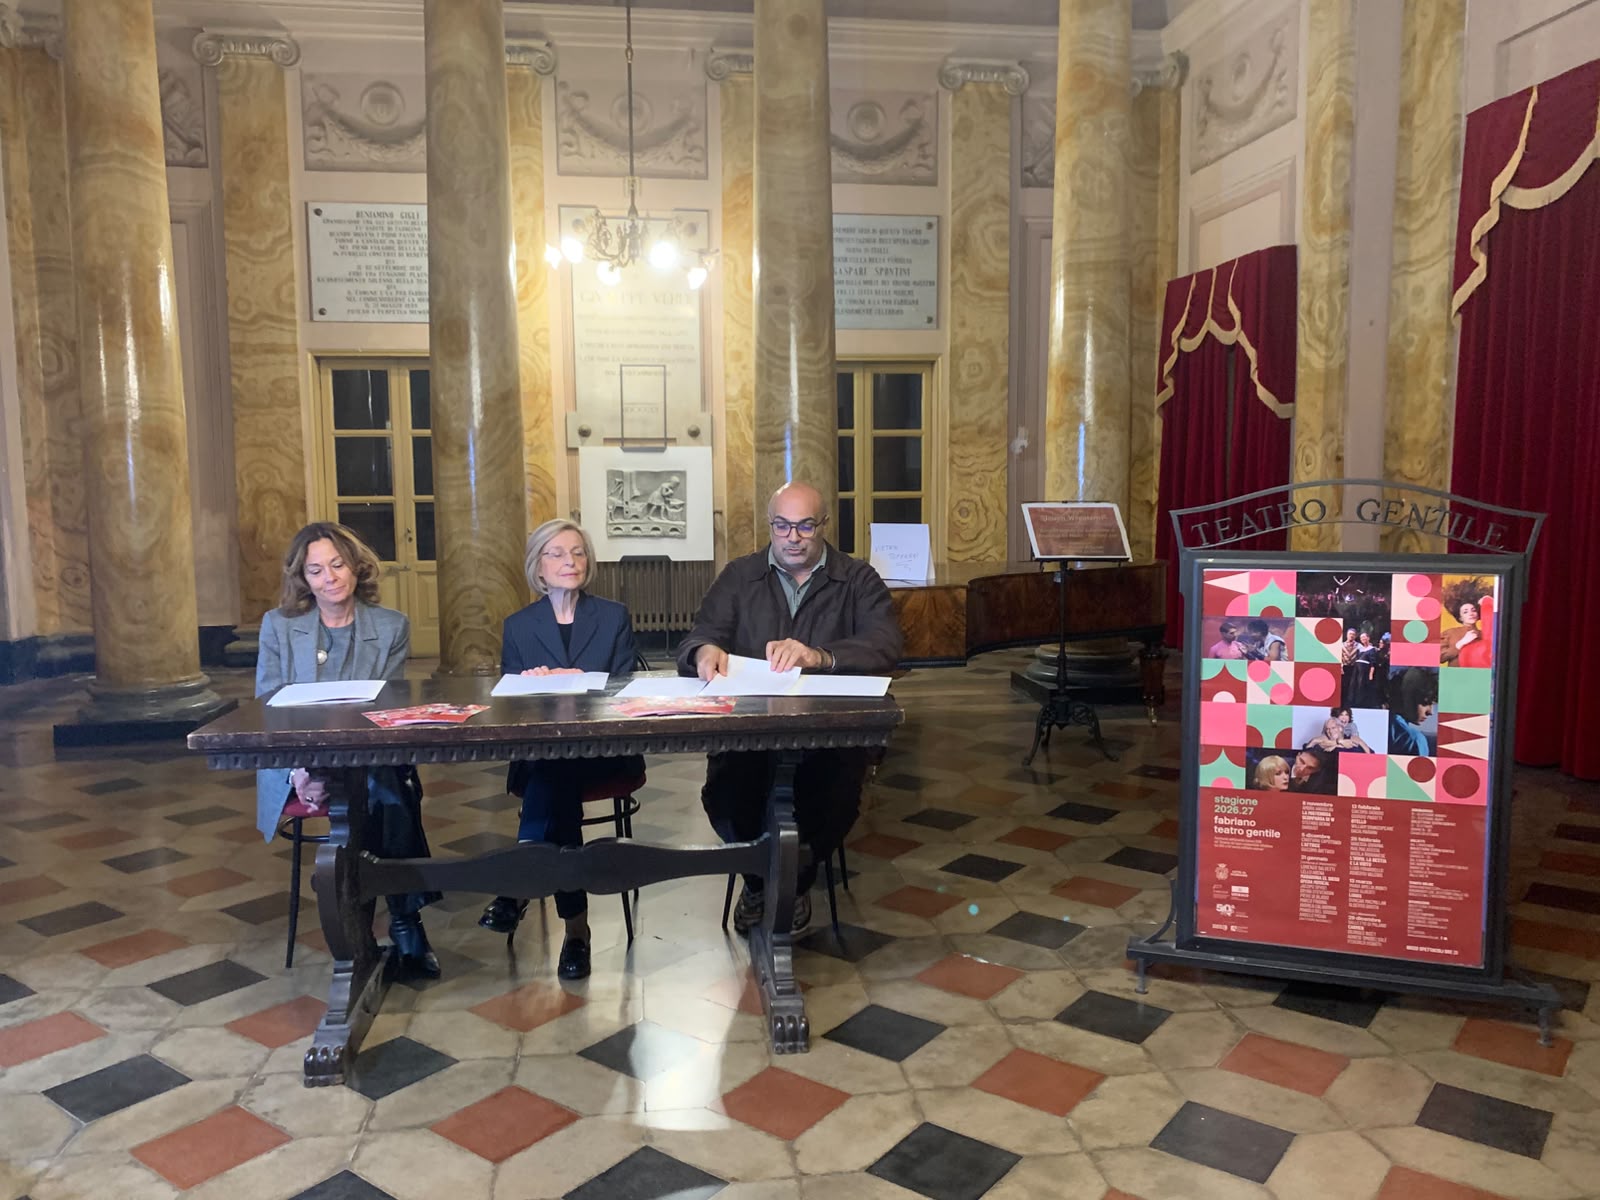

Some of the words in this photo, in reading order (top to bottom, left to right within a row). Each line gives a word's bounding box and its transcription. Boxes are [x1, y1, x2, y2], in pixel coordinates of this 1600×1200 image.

[1191, 498, 1326, 546] TEATRO
[1356, 498, 1509, 549] GENTILE
[1214, 796, 1258, 806] stagione
[1214, 804, 1254, 815] 2026.27
[1214, 816, 1256, 826] fabriano
[1214, 826, 1244, 835] teatro
[1246, 829, 1280, 838] gentile
